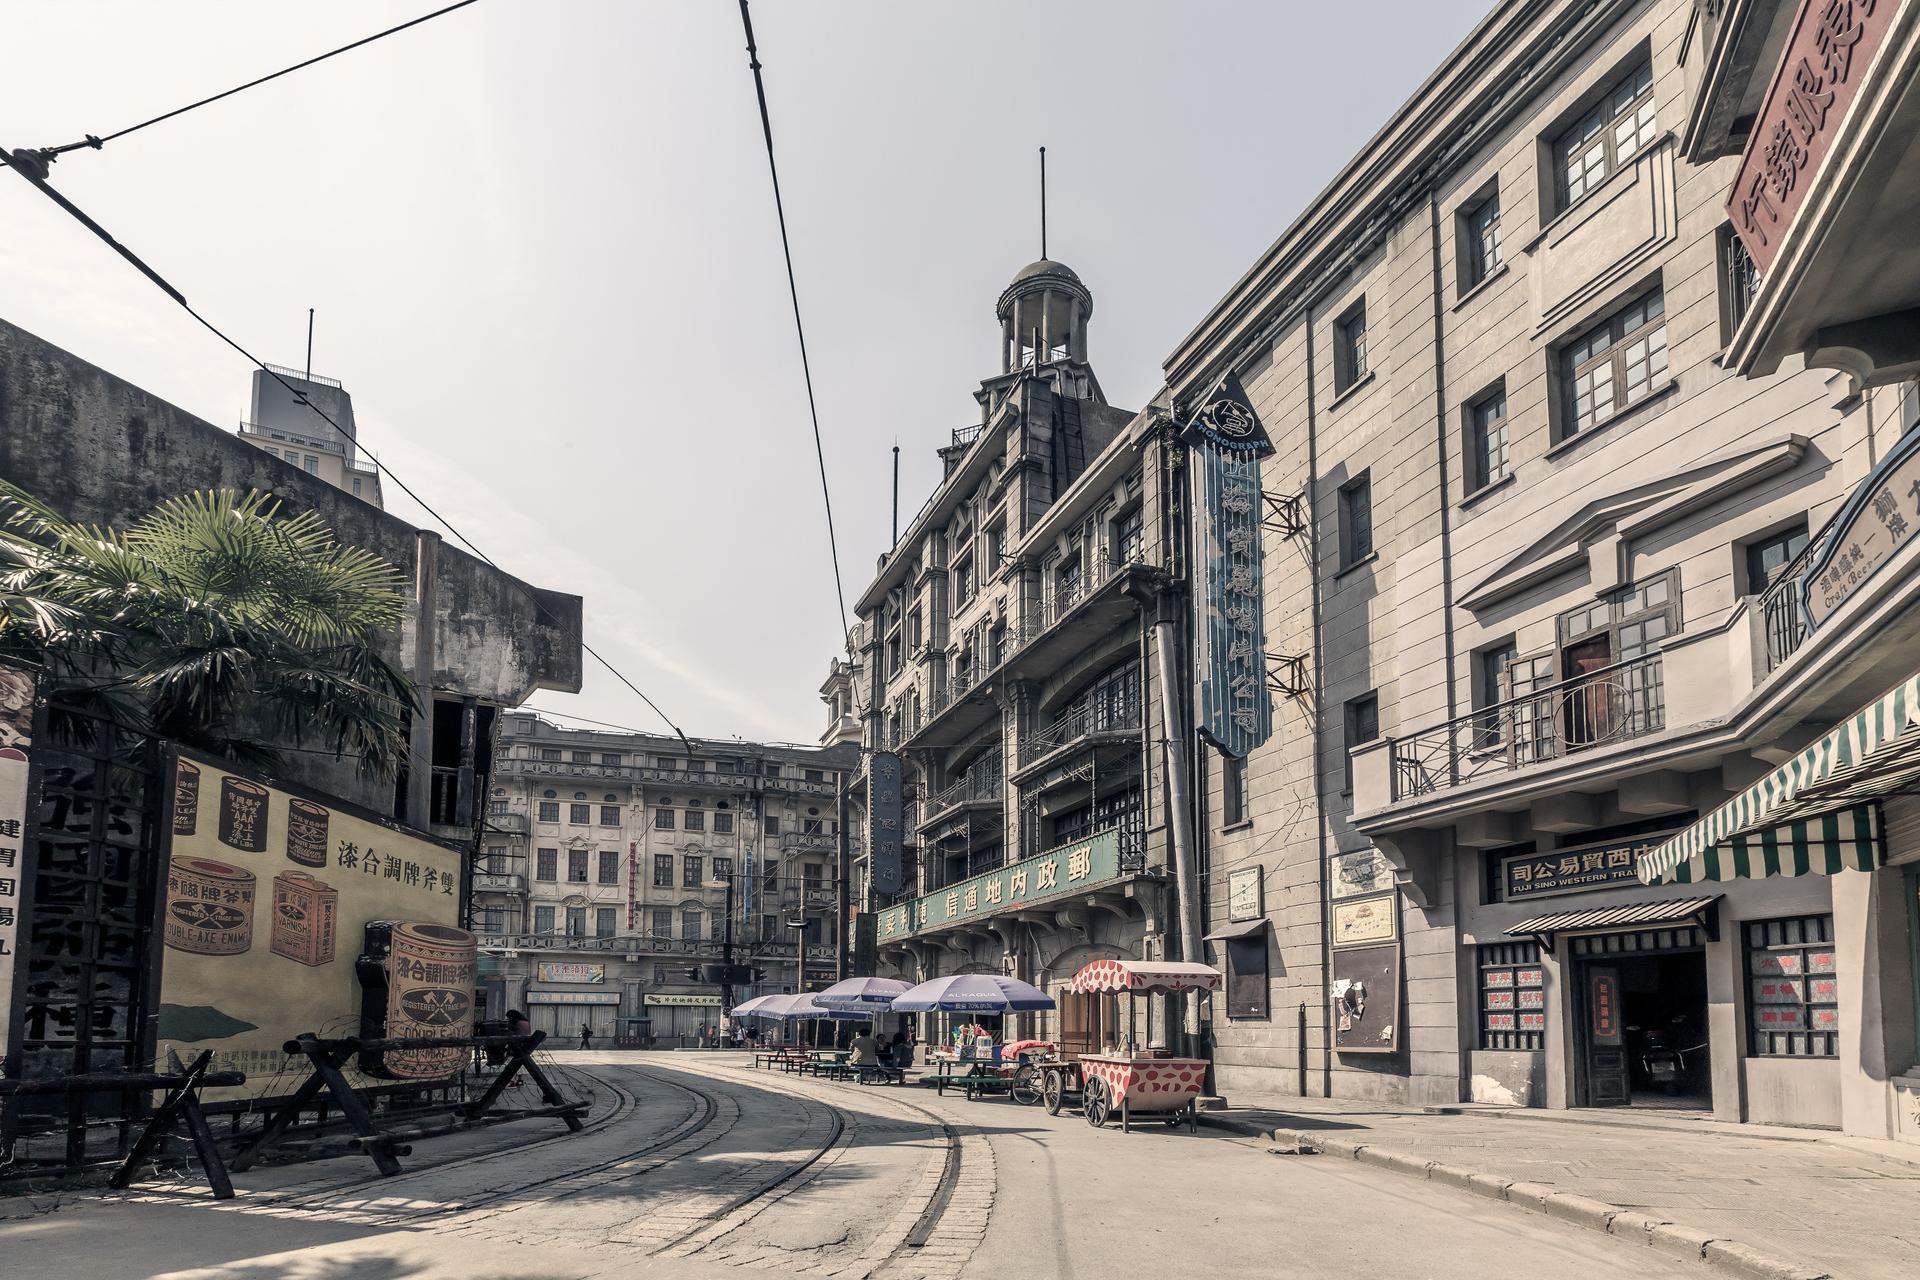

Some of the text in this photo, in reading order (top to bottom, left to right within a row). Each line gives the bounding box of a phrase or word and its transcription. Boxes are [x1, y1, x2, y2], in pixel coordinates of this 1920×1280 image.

[1742, 0, 1876, 246] 表眼鏡行
[1192, 420, 1269, 450] PHONOGRAPH
[1824, 562, 1873, 609] Craft Beer
[1513, 884, 1531, 892] FUJI
[1535, 880, 1556, 889] SINO
[1560, 873, 1607, 885] WESTERN
[278, 916, 307, 934] VARNISH
